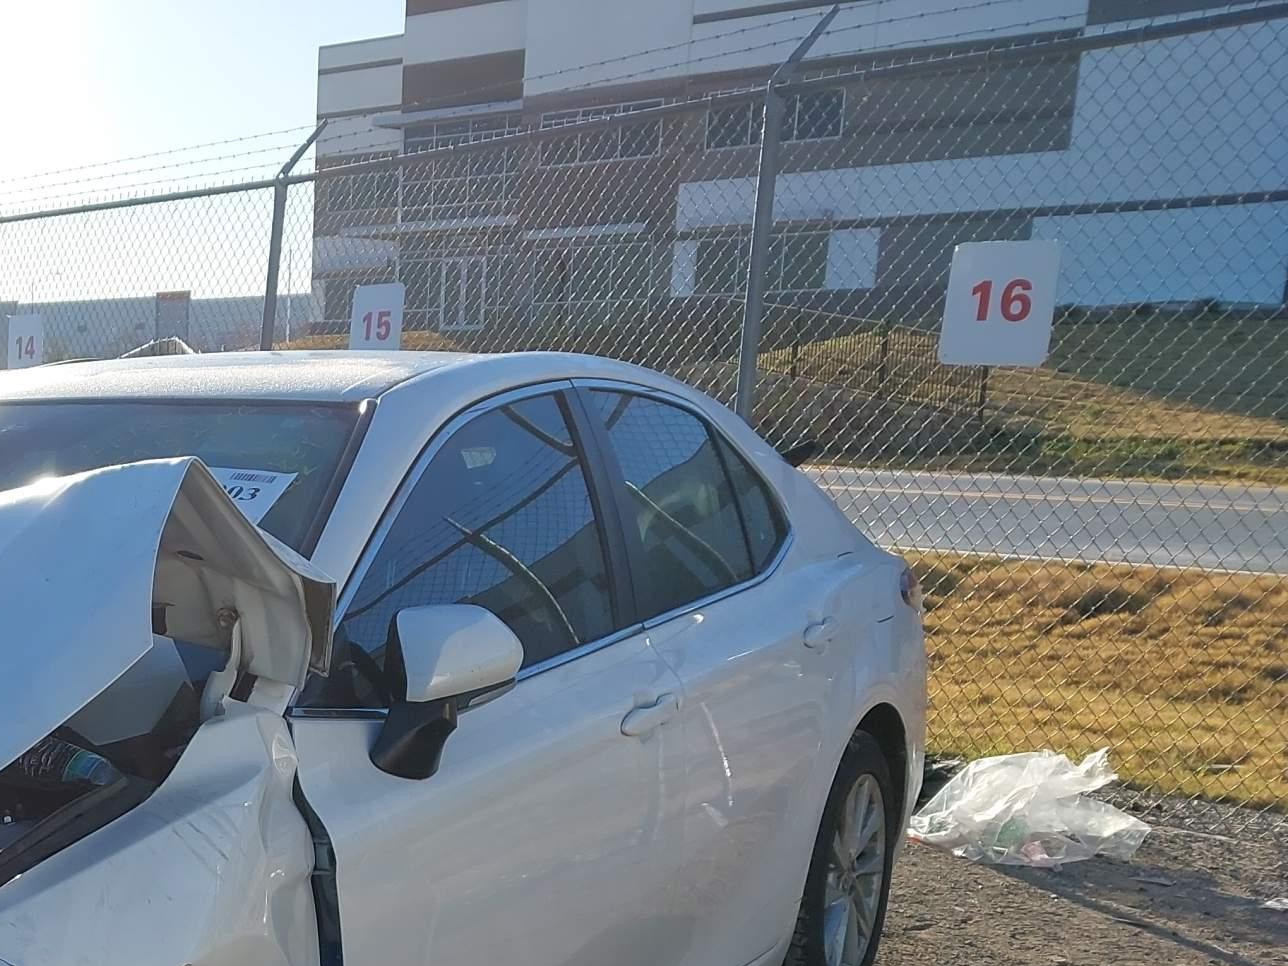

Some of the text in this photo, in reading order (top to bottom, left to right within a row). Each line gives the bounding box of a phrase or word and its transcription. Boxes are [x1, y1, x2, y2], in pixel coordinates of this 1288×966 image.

[971, 278, 1033, 322] 16
[362, 310, 392, 341] 15
[15, 335, 36, 360] 14
[223, 484, 261, 501] 03
